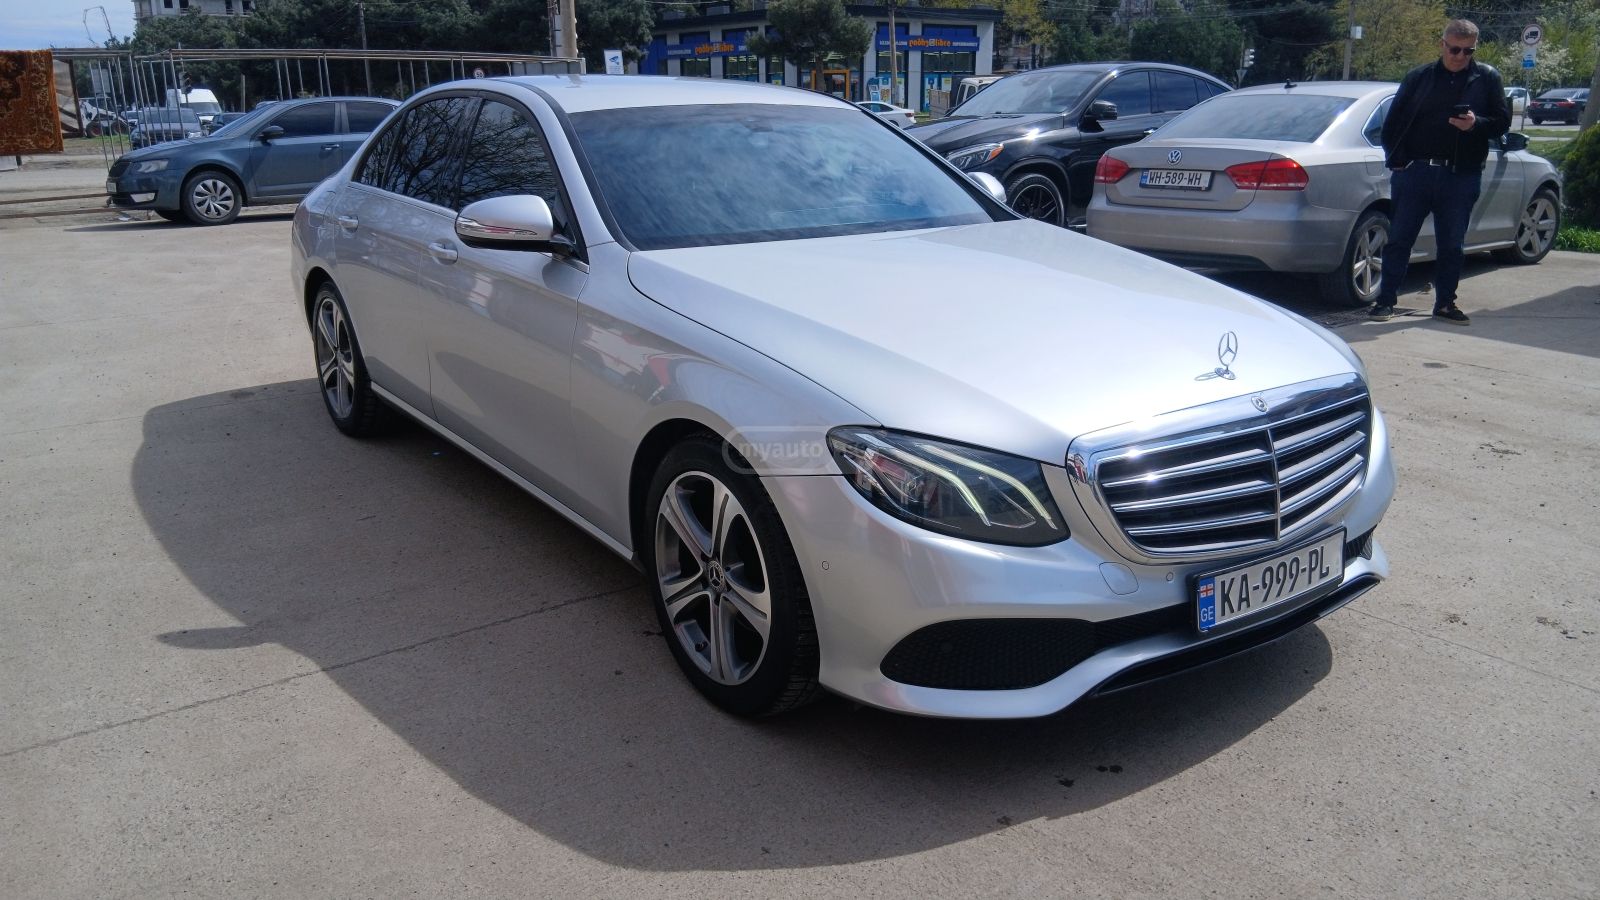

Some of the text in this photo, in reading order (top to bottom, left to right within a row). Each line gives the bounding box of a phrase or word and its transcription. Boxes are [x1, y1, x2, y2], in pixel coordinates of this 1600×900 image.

[1148, 171, 1202, 186] WH-589-WH
[1220, 546, 1329, 616] KA-999-PL
[1200, 605, 1214, 622] GE
